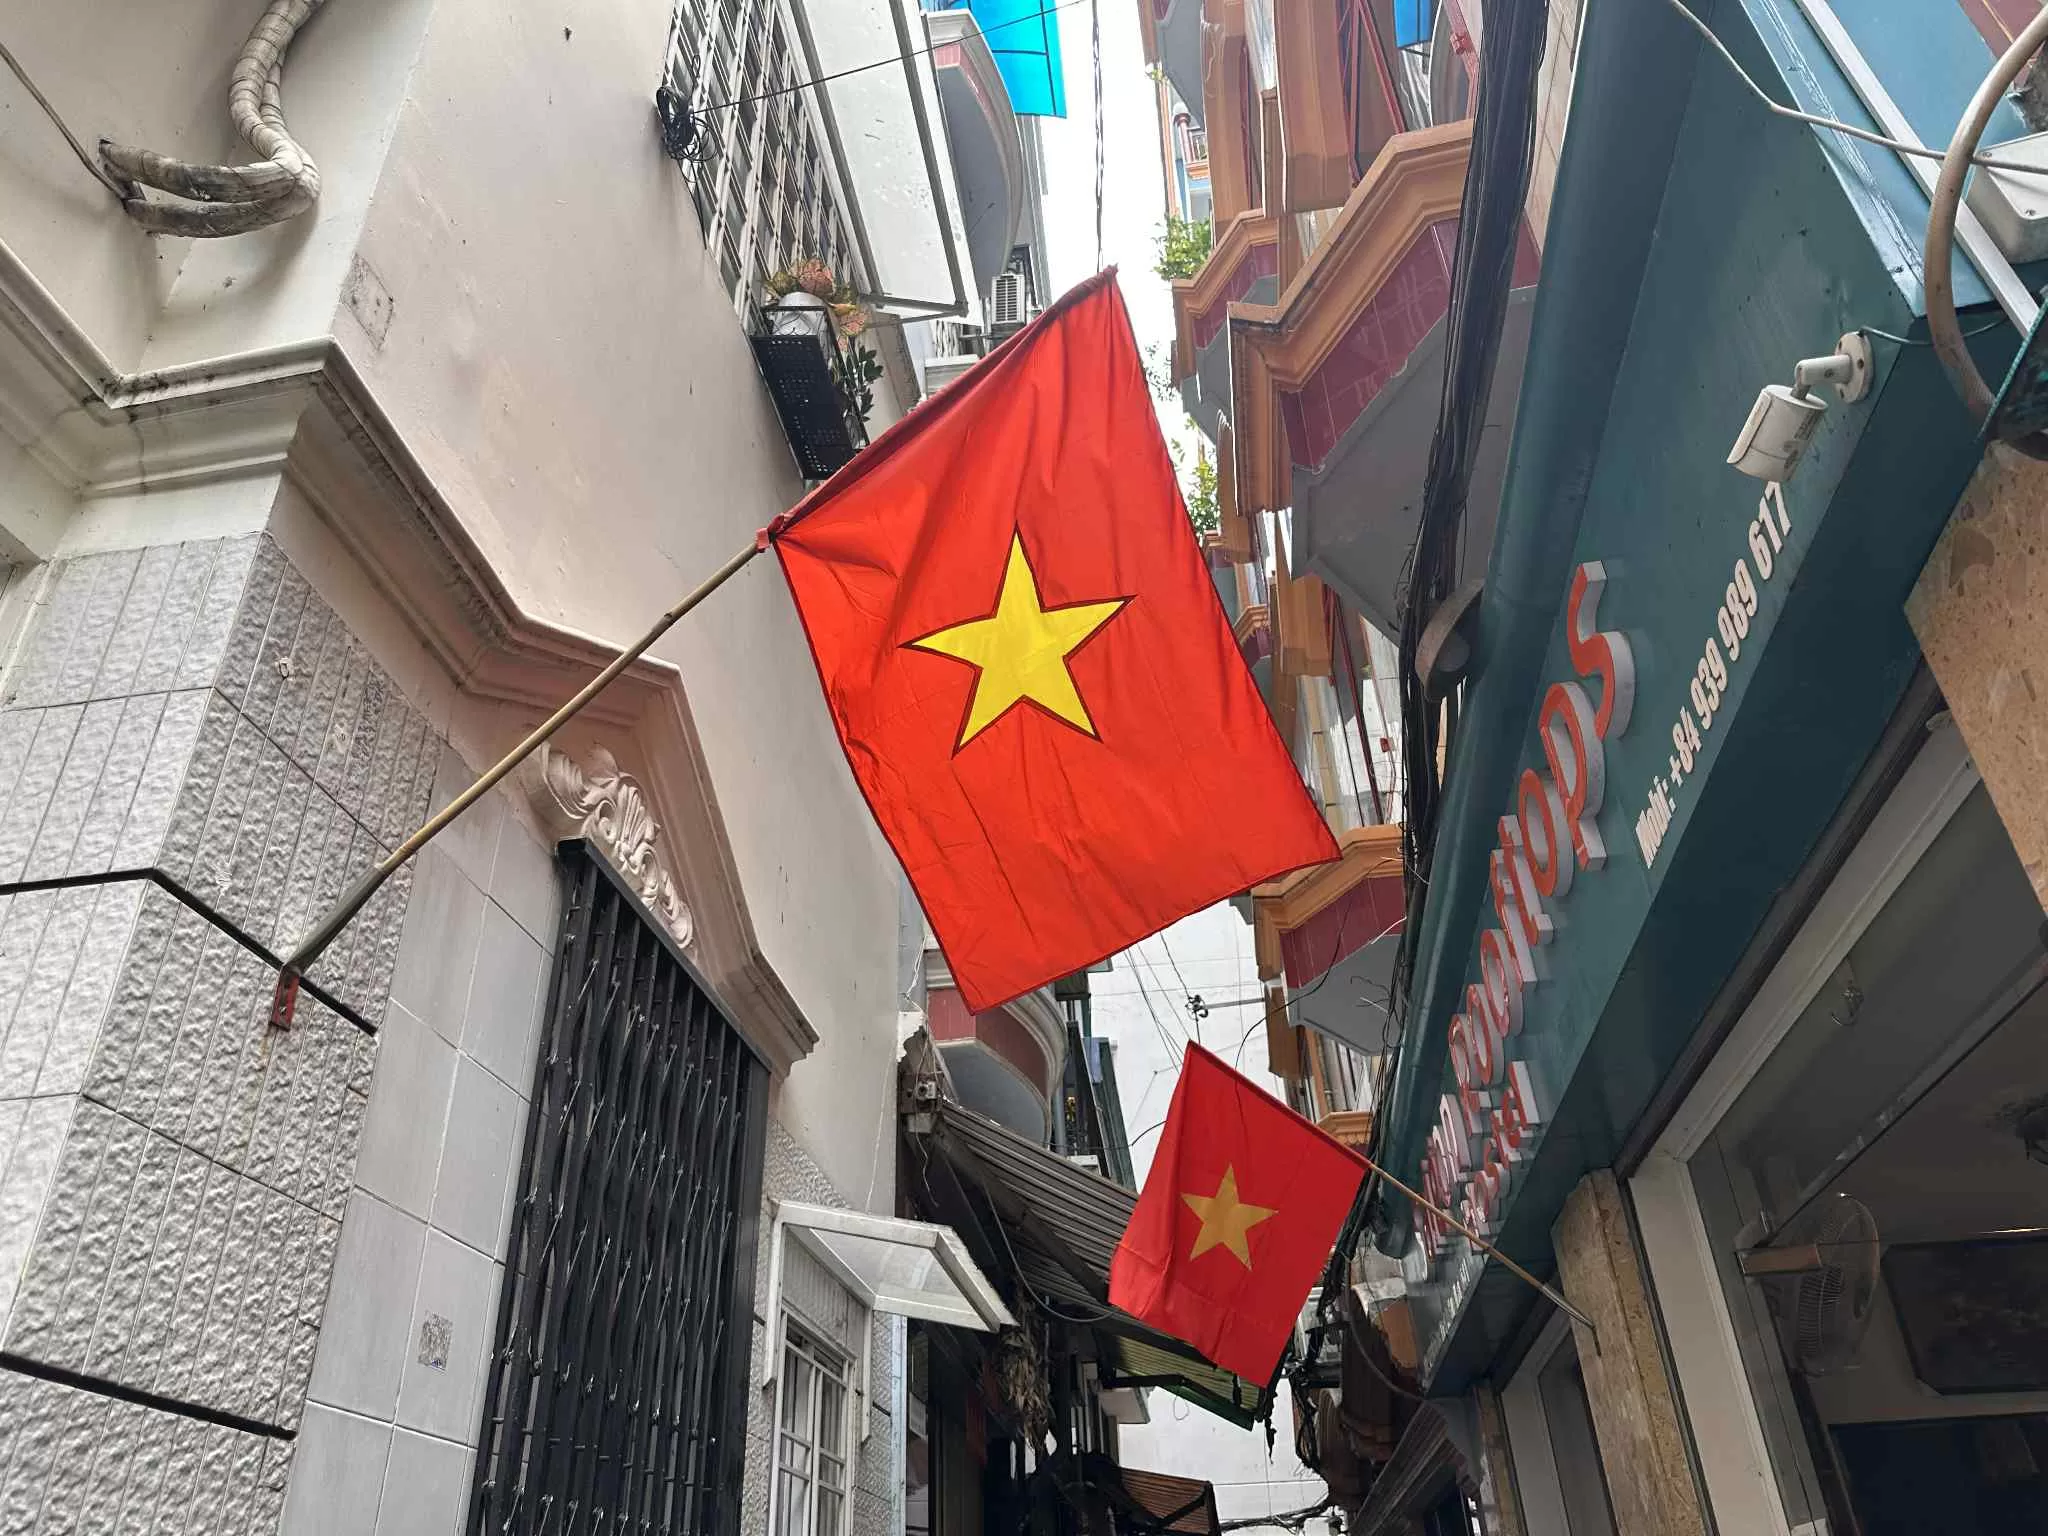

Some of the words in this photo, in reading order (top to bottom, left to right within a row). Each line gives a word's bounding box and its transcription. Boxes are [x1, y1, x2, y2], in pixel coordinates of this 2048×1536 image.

[1670, 706, 1702, 787] +84
[1690, 637, 1728, 730] 939
[1717, 558, 1758, 663] 989
[1748, 481, 1793, 580] 617
